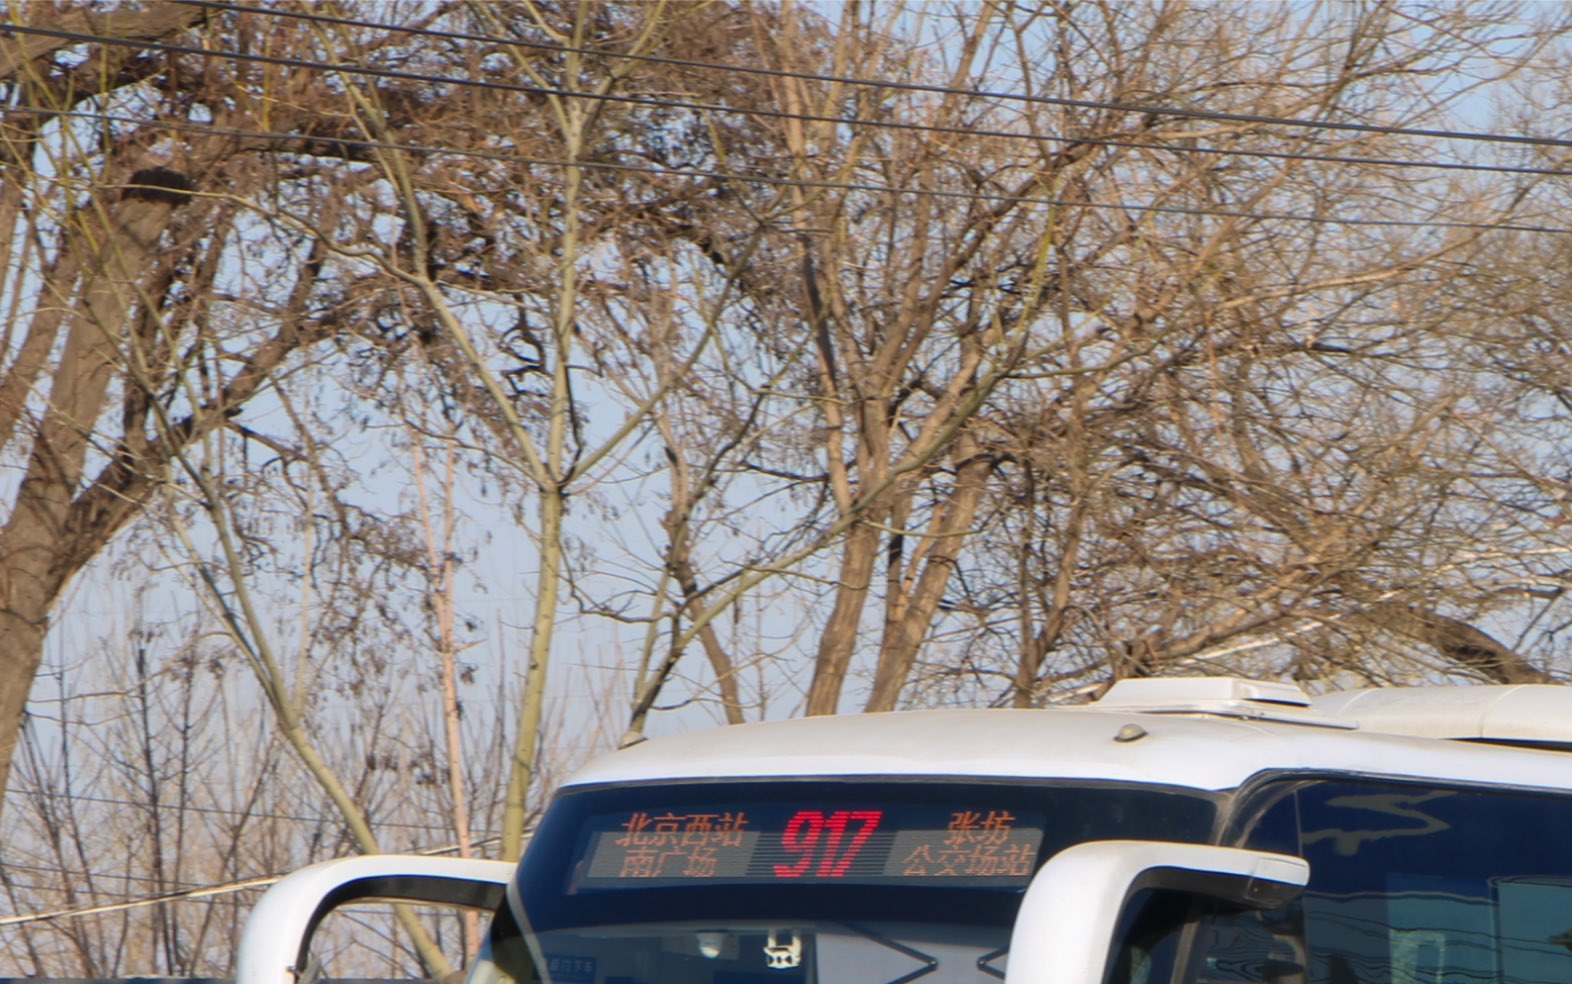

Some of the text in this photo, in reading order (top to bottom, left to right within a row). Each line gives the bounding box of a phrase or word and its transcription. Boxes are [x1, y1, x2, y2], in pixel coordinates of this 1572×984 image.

[614, 812, 749, 847] 北京西站
[772, 811, 882, 878] 917
[943, 811, 1016, 845] 张坊
[619, 846, 720, 878] 南广场
[902, 843, 1037, 876] 公交场站
